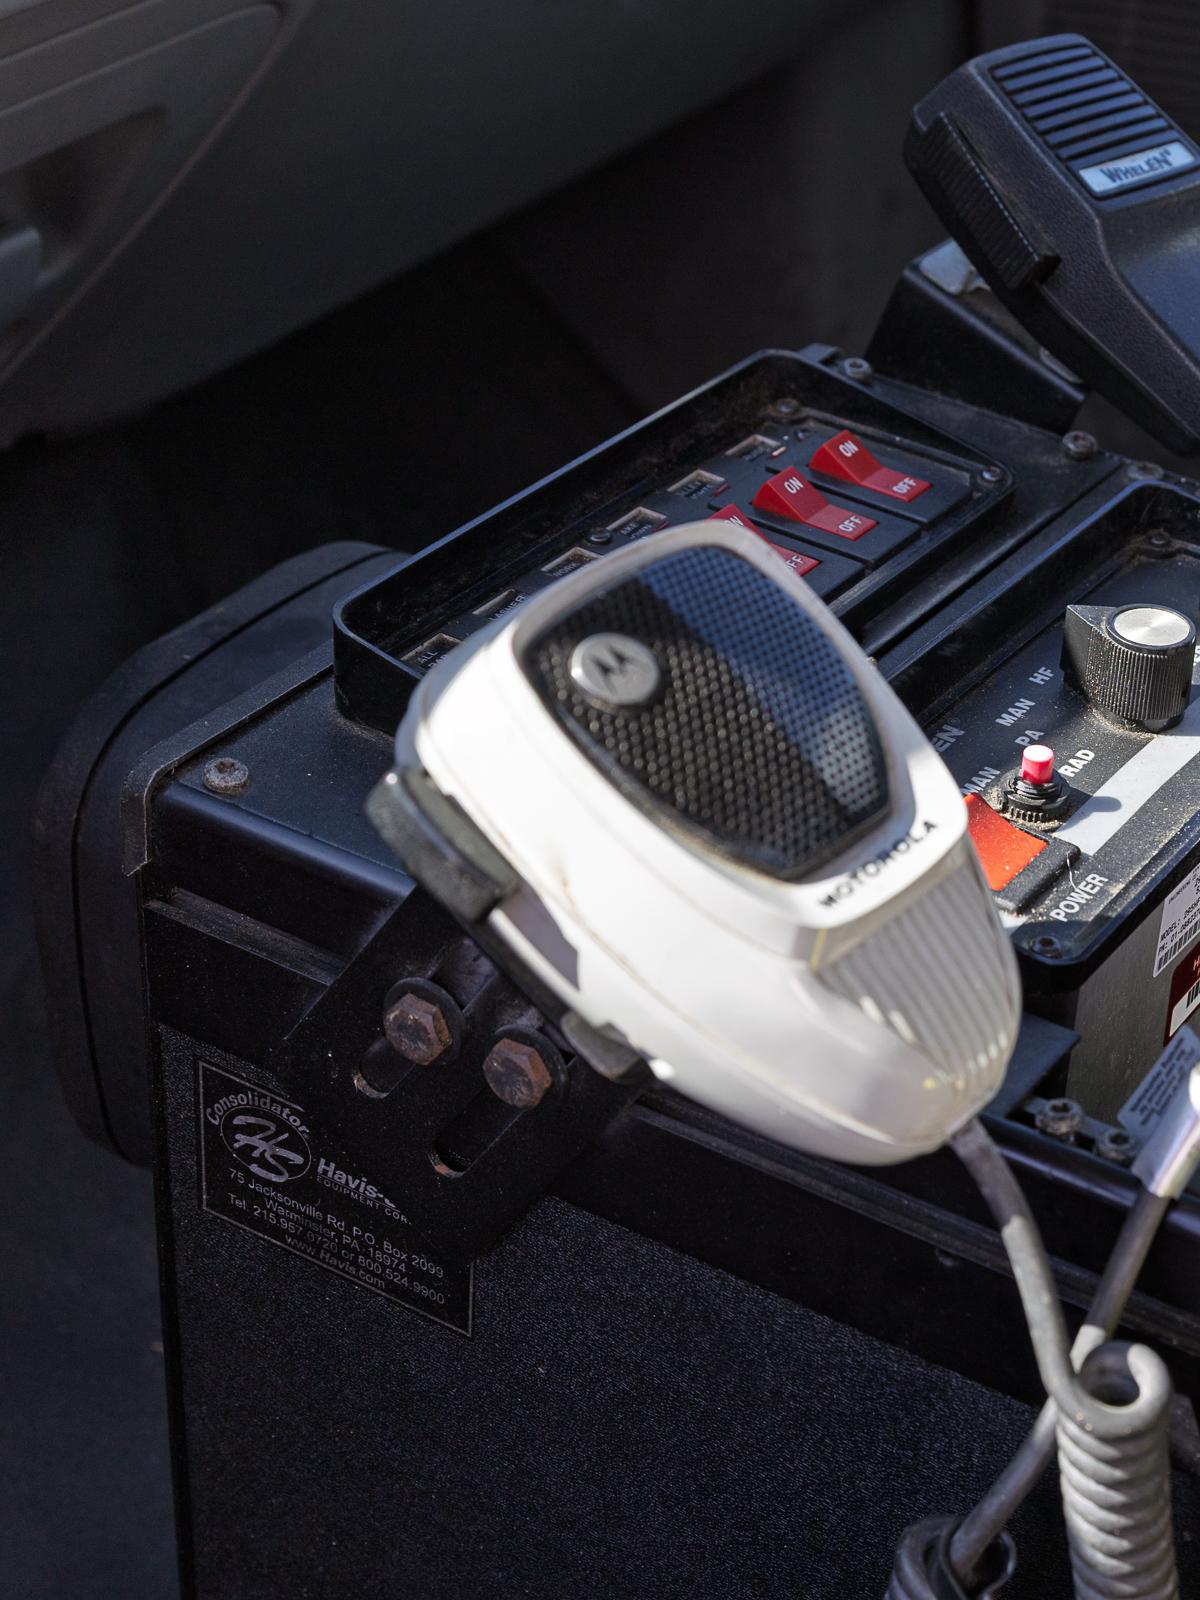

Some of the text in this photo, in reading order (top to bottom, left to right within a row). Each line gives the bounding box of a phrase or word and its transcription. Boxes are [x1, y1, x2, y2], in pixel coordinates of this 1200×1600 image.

[838, 440, 859, 457] ON
[784, 477, 804, 494] ON
[892, 477, 917, 494] OFF
[839, 515, 863, 533] OFF
[787, 555, 804, 570] FF
[1029, 666, 1055, 685] HF
[995, 698, 1036, 727] MAN
[1014, 729, 1045, 747] PA
[1058, 749, 1095, 778] RAD
[960, 766, 1000, 795] MAN
[819, 821, 937, 907] MOTOROLA
[1049, 873, 1109, 922] POWER
[206, 1091, 310, 1133] Consolidator
[317, 1175, 380, 1209] EQUIPMENT
[228, 1168, 245, 1184] 75
[248, 1179, 323, 1221] Jacksonville
[383, 1240, 408, 1261] Box
[411, 1254, 444, 1278] 2099
[341, 1249, 355, 1261] or
[342, 1234, 360, 1251] PA
[368, 1247, 406, 1272] 18974
